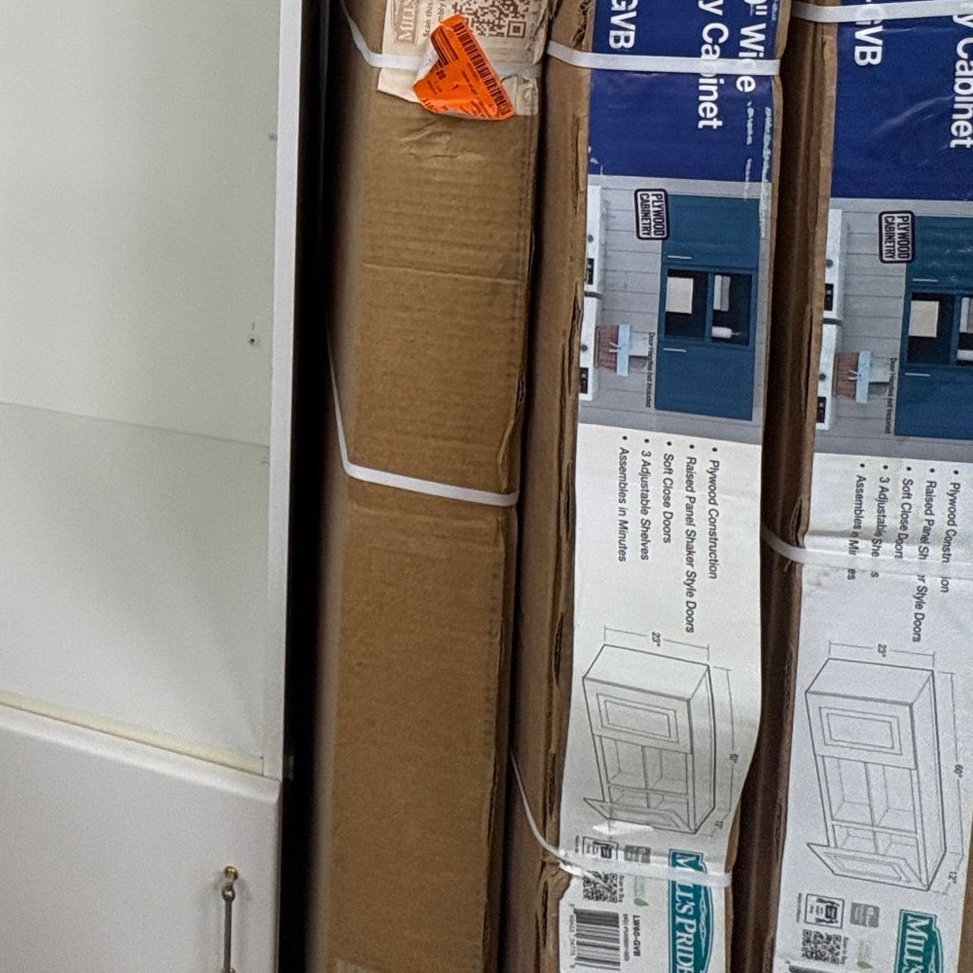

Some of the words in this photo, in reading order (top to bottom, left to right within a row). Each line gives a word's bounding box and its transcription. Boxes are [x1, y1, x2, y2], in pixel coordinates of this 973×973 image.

[422, 19, 431, 37] Scan
[424, 2, 434, 17] this
[697, 22, 730, 129] Cainet
[735, 23, 767, 93] Wie
[639, 192, 652, 237] CABINETRY
[651, 193, 666, 236] PLYWOOD
[883, 215, 897, 260] CABINETRY
[897, 215, 911, 259] PLYWOOD
[641, 449, 651, 457] 3
[662, 453, 674, 475] Soft
[618, 447, 630, 505] Assembles
[638, 459, 652, 516] Adjustable
[662, 477, 674, 508] Close
[685, 456, 697, 493] Raised
[706, 460, 720, 505] Plywood
[901, 478, 914, 500] Soft
[618, 506, 629, 517] in
[685, 495, 697, 526] Panel
[852, 475, 867, 530] Assembles
[899, 502, 912, 531] Close
[924, 480, 937, 517] Raised
[946, 482, 961, 527] Plywood
[617, 519, 629, 563] Minutes
[640, 518, 652, 561] Shelves
[662, 510, 674, 544] Doors
[707, 508, 720, 580] Construction
[919, 518, 935, 544] Panel
[685, 529, 697, 568] Shaker
[870, 538, 883, 578] Shes
[683, 570, 697, 598] Style
[912, 585, 928, 610] Style
[685, 600, 697, 634] Doors
[912, 612, 927, 643] Doors
[674, 853, 697, 916] MLL'S
[632, 914, 642, 957] LW60-GVB
